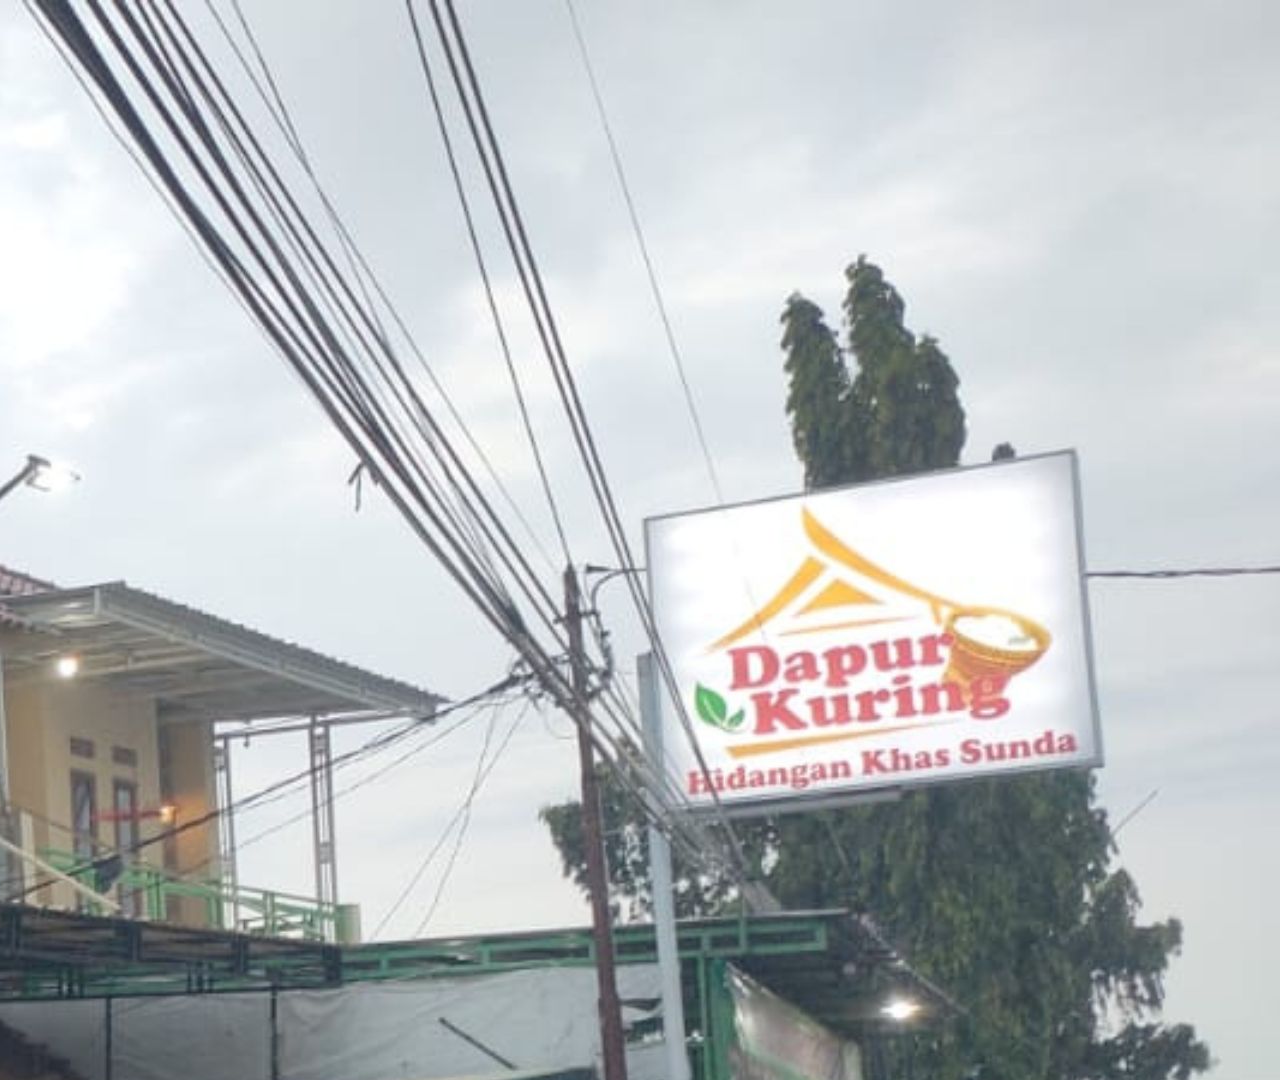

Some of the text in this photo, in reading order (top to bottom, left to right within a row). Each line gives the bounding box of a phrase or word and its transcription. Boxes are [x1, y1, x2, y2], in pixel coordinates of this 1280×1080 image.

[727, 631, 956, 692] Dapur
[751, 674, 1011, 736] Kuring
[687, 730, 1078, 796] Hidangan Khas Sunda
